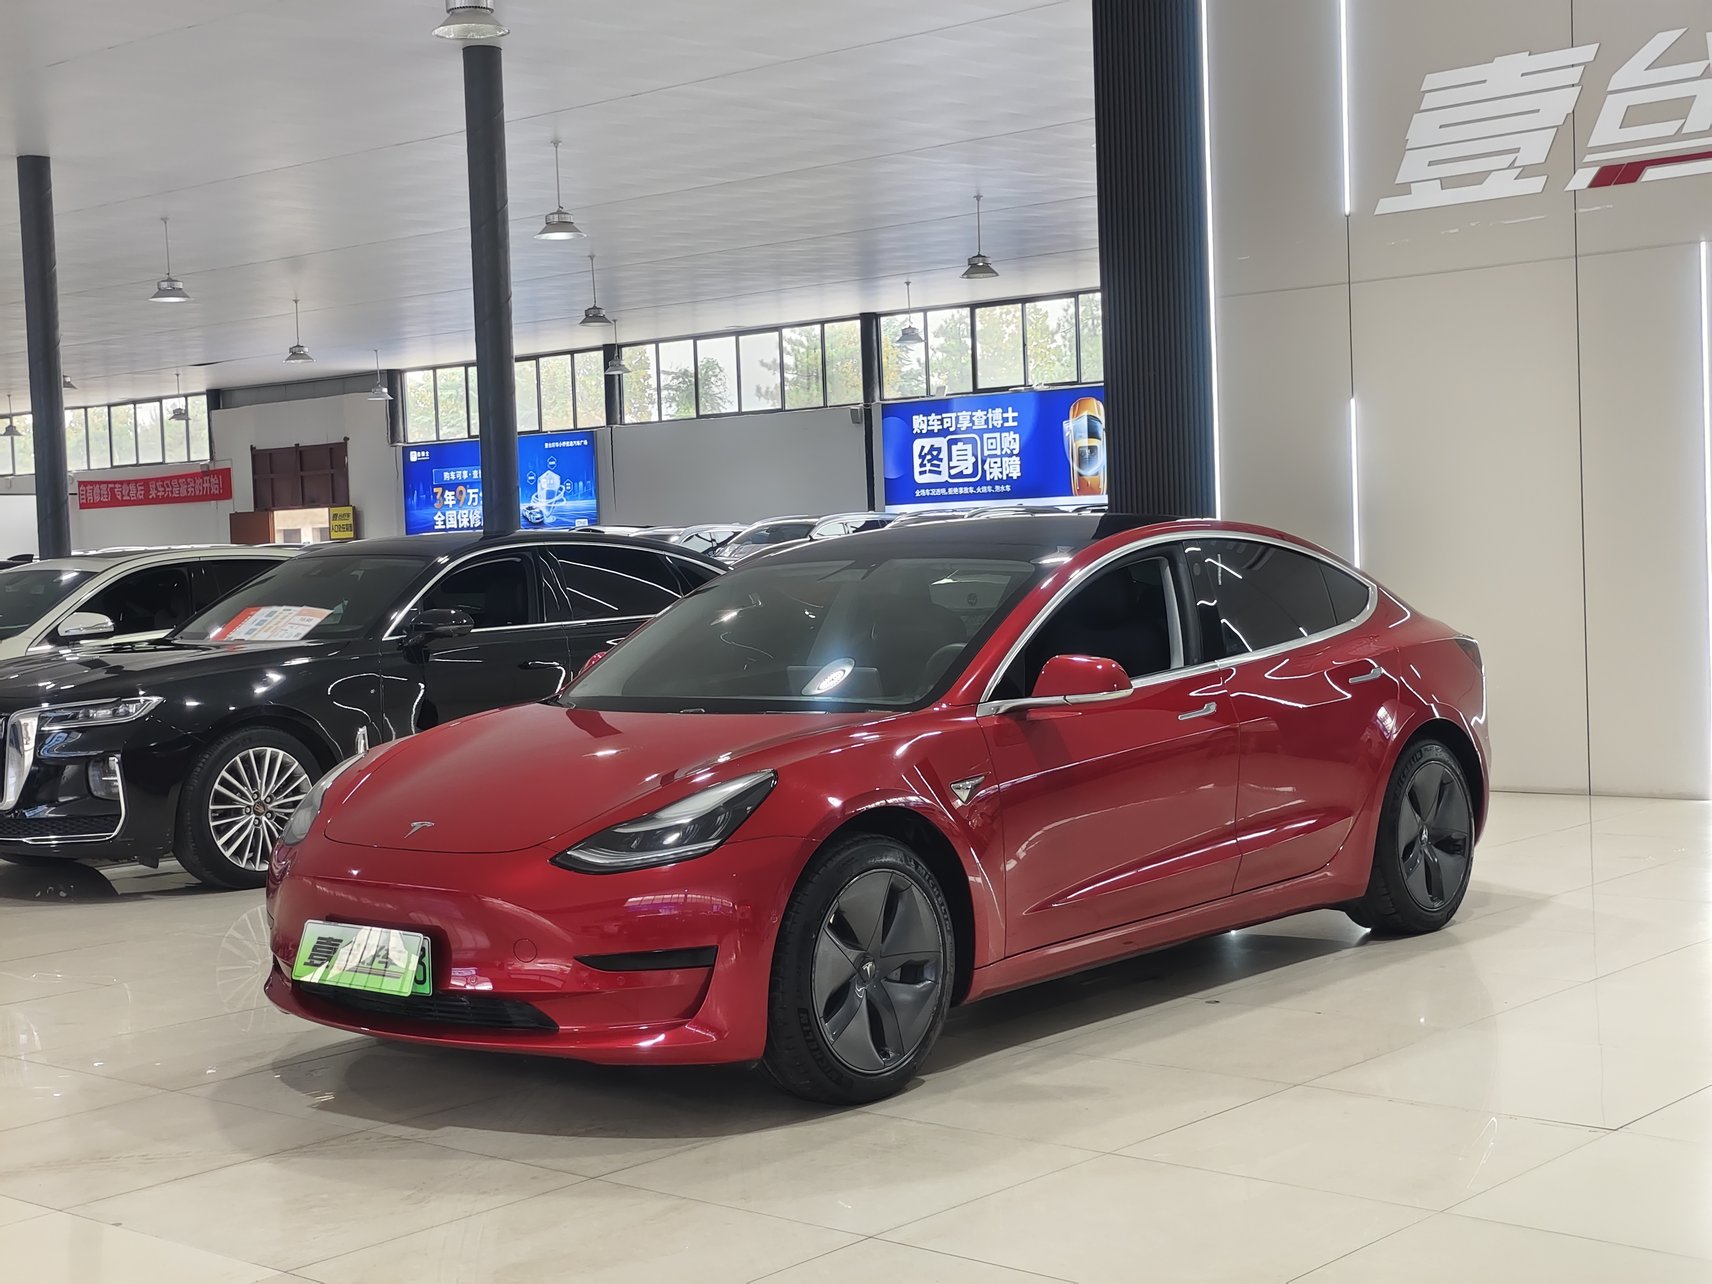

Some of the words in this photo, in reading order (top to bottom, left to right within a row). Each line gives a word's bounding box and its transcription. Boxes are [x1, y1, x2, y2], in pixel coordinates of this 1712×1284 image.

[912, 407, 1019, 434] 购车可享查博士
[983, 431, 1020, 456] 回购
[916, 440, 978, 477] 终身
[983, 456, 1022, 481] 保障
[443, 469, 482, 481] 购车可享·查
[433, 485, 482, 509] 3年9万
[433, 510, 483, 529] 全国保修
